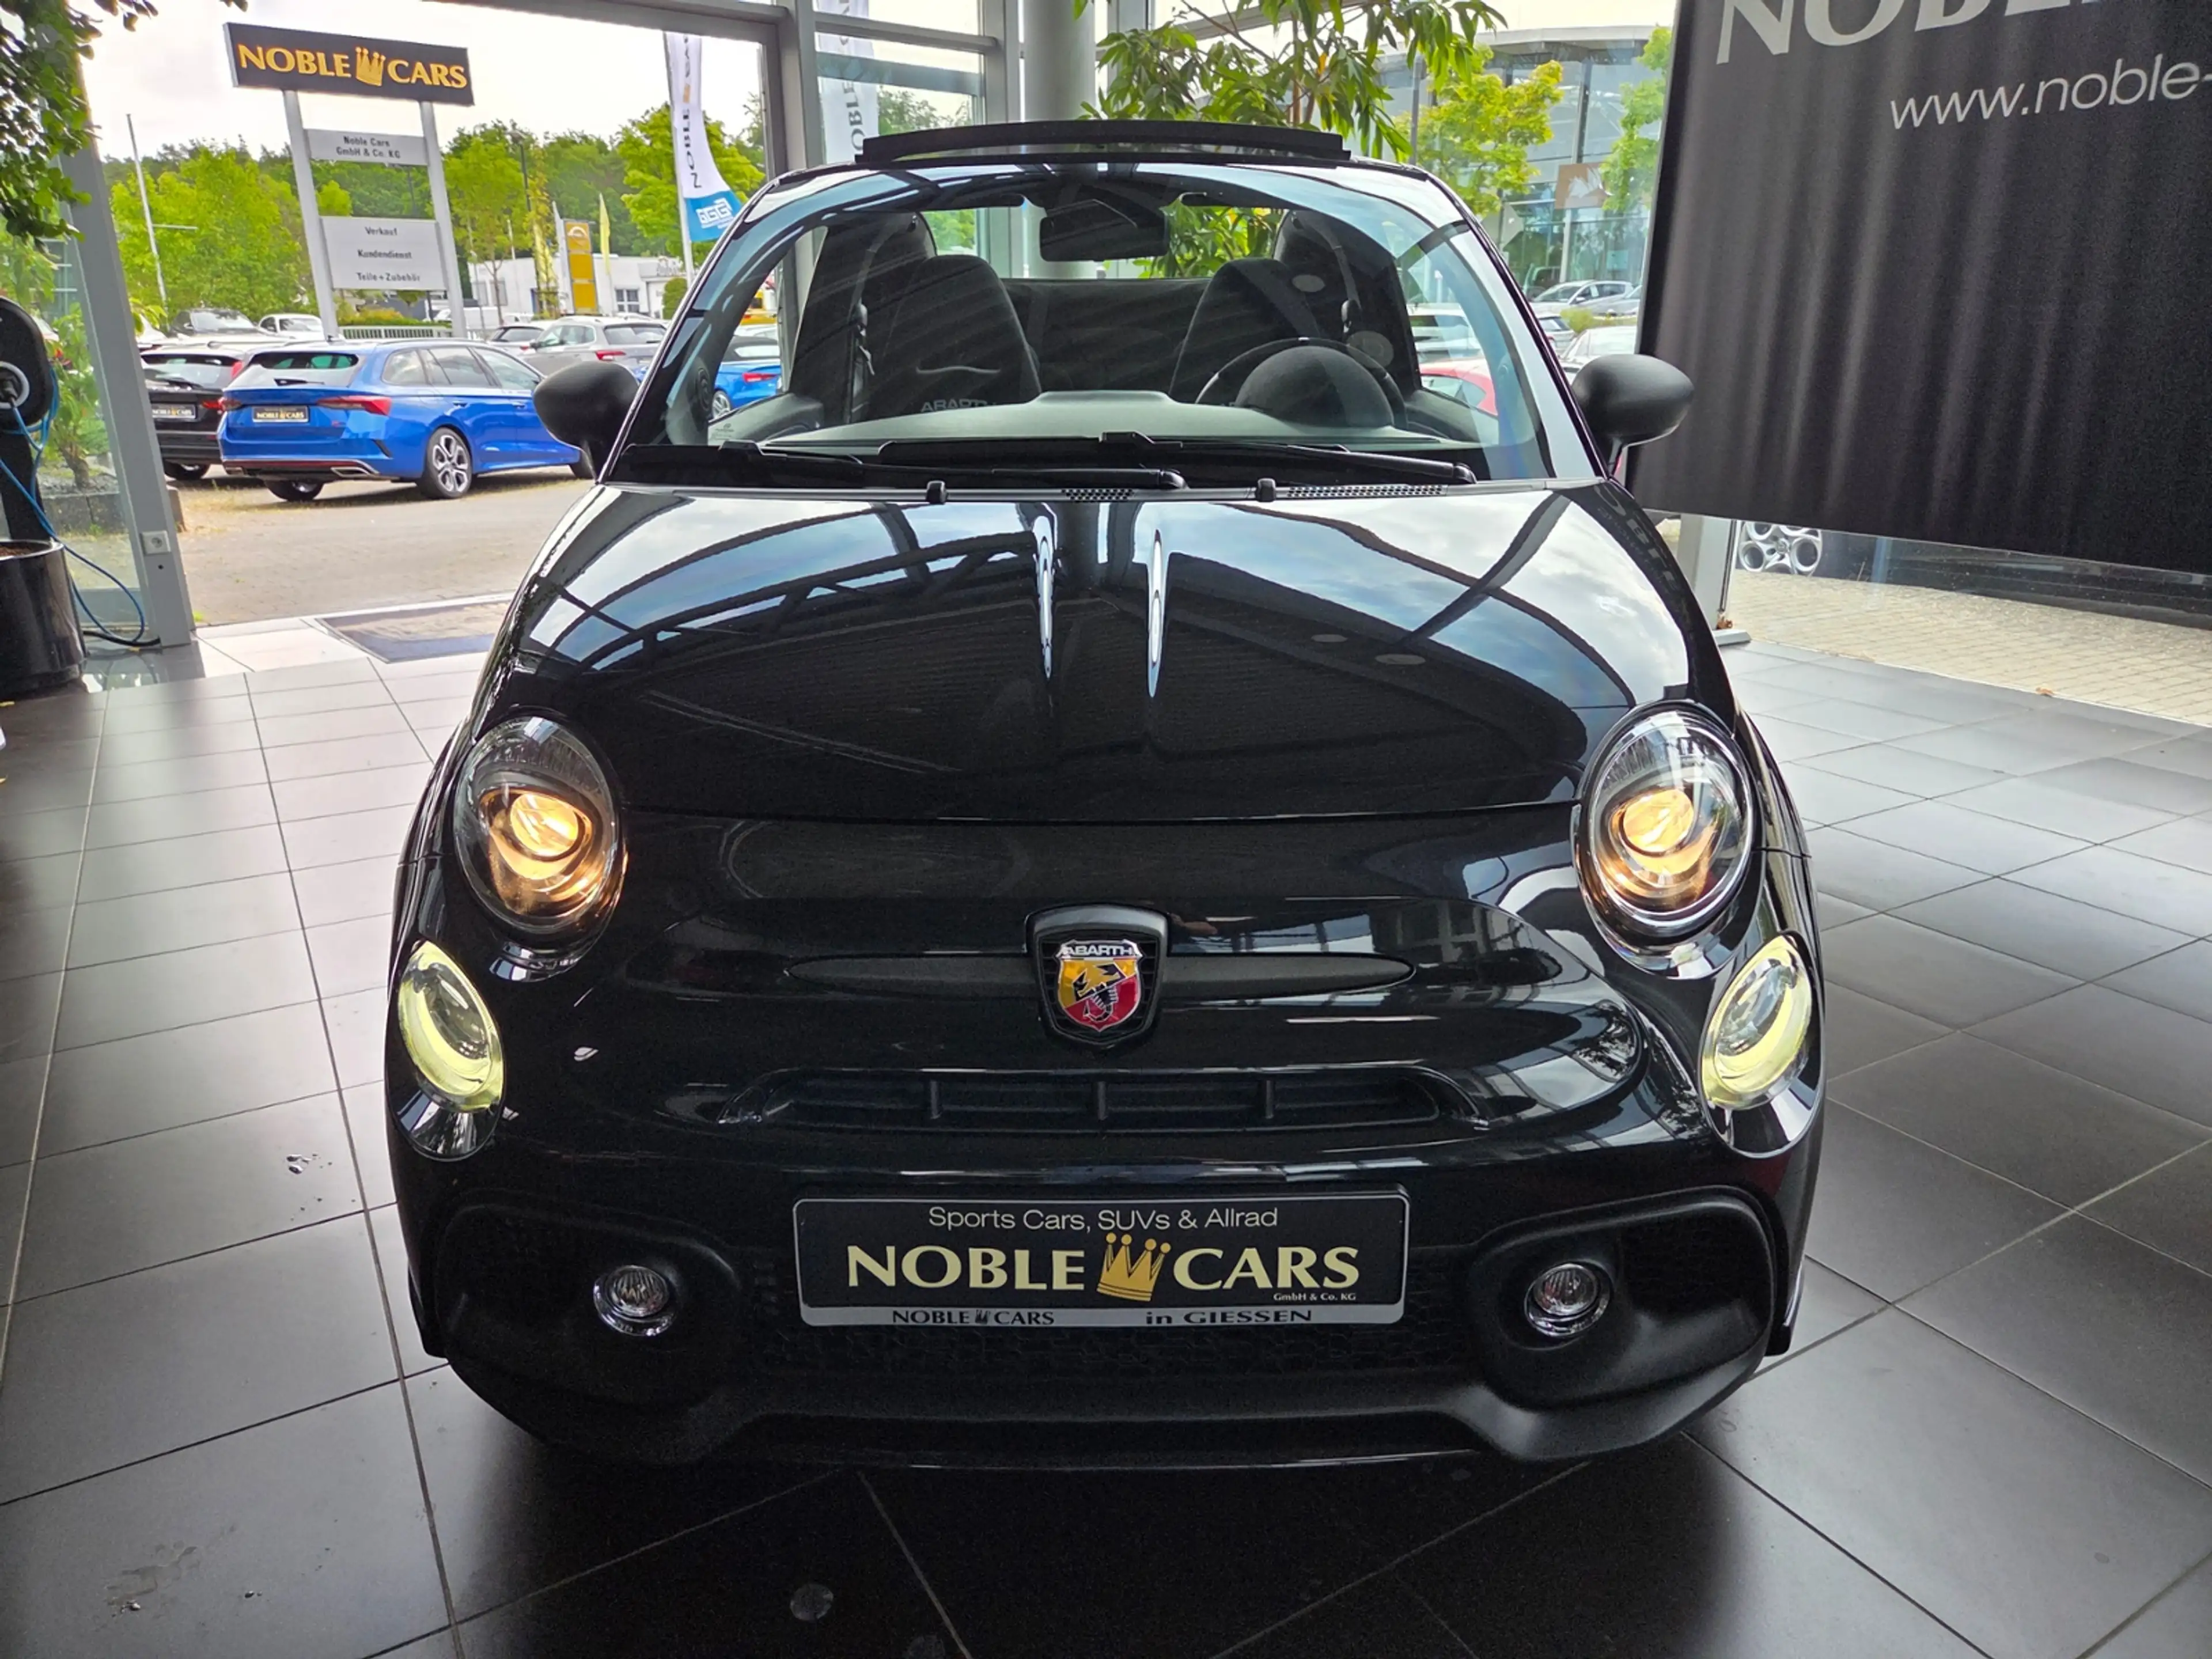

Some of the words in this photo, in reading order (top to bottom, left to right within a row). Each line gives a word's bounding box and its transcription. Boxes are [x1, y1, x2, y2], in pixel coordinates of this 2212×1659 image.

[237, 44, 351, 78] NOBLE
[388, 59, 468, 88] CARS
[343, 135, 368, 146] Noble
[370, 138, 390, 147] Cars
[336, 146, 360, 156] GmbH
[363, 148, 370, 157] &
[388, 150, 401, 158] KG
[365, 226, 397, 236] Verkauf
[357, 249, 412, 259] Kundendienst
[1062, 944, 1132, 956] ABARTH
[929, 1206, 1016, 1231] Sports
[1022, 1209, 1090, 1233] Cars,
[1097, 1209, 1170, 1230] SUVs
[1178, 1209, 1198, 1229] &
[1205, 1207, 1278, 1228] Allrad
[847, 1245, 1085, 1290] NOBLE
[1173, 1246, 1359, 1290] CARS
[1274, 1293, 1307, 1301] GmbH
[1309, 1293, 1317, 1301] &
[1320, 1293, 1338, 1301] Co.
[1340, 1293, 1357, 1301] KG
[892, 1309, 970, 1324] NOBLE
[994, 1310, 1055, 1325] CARS
[1146, 1311, 1173, 1324] in
[1184, 1309, 1312, 1324] GIESSEN
